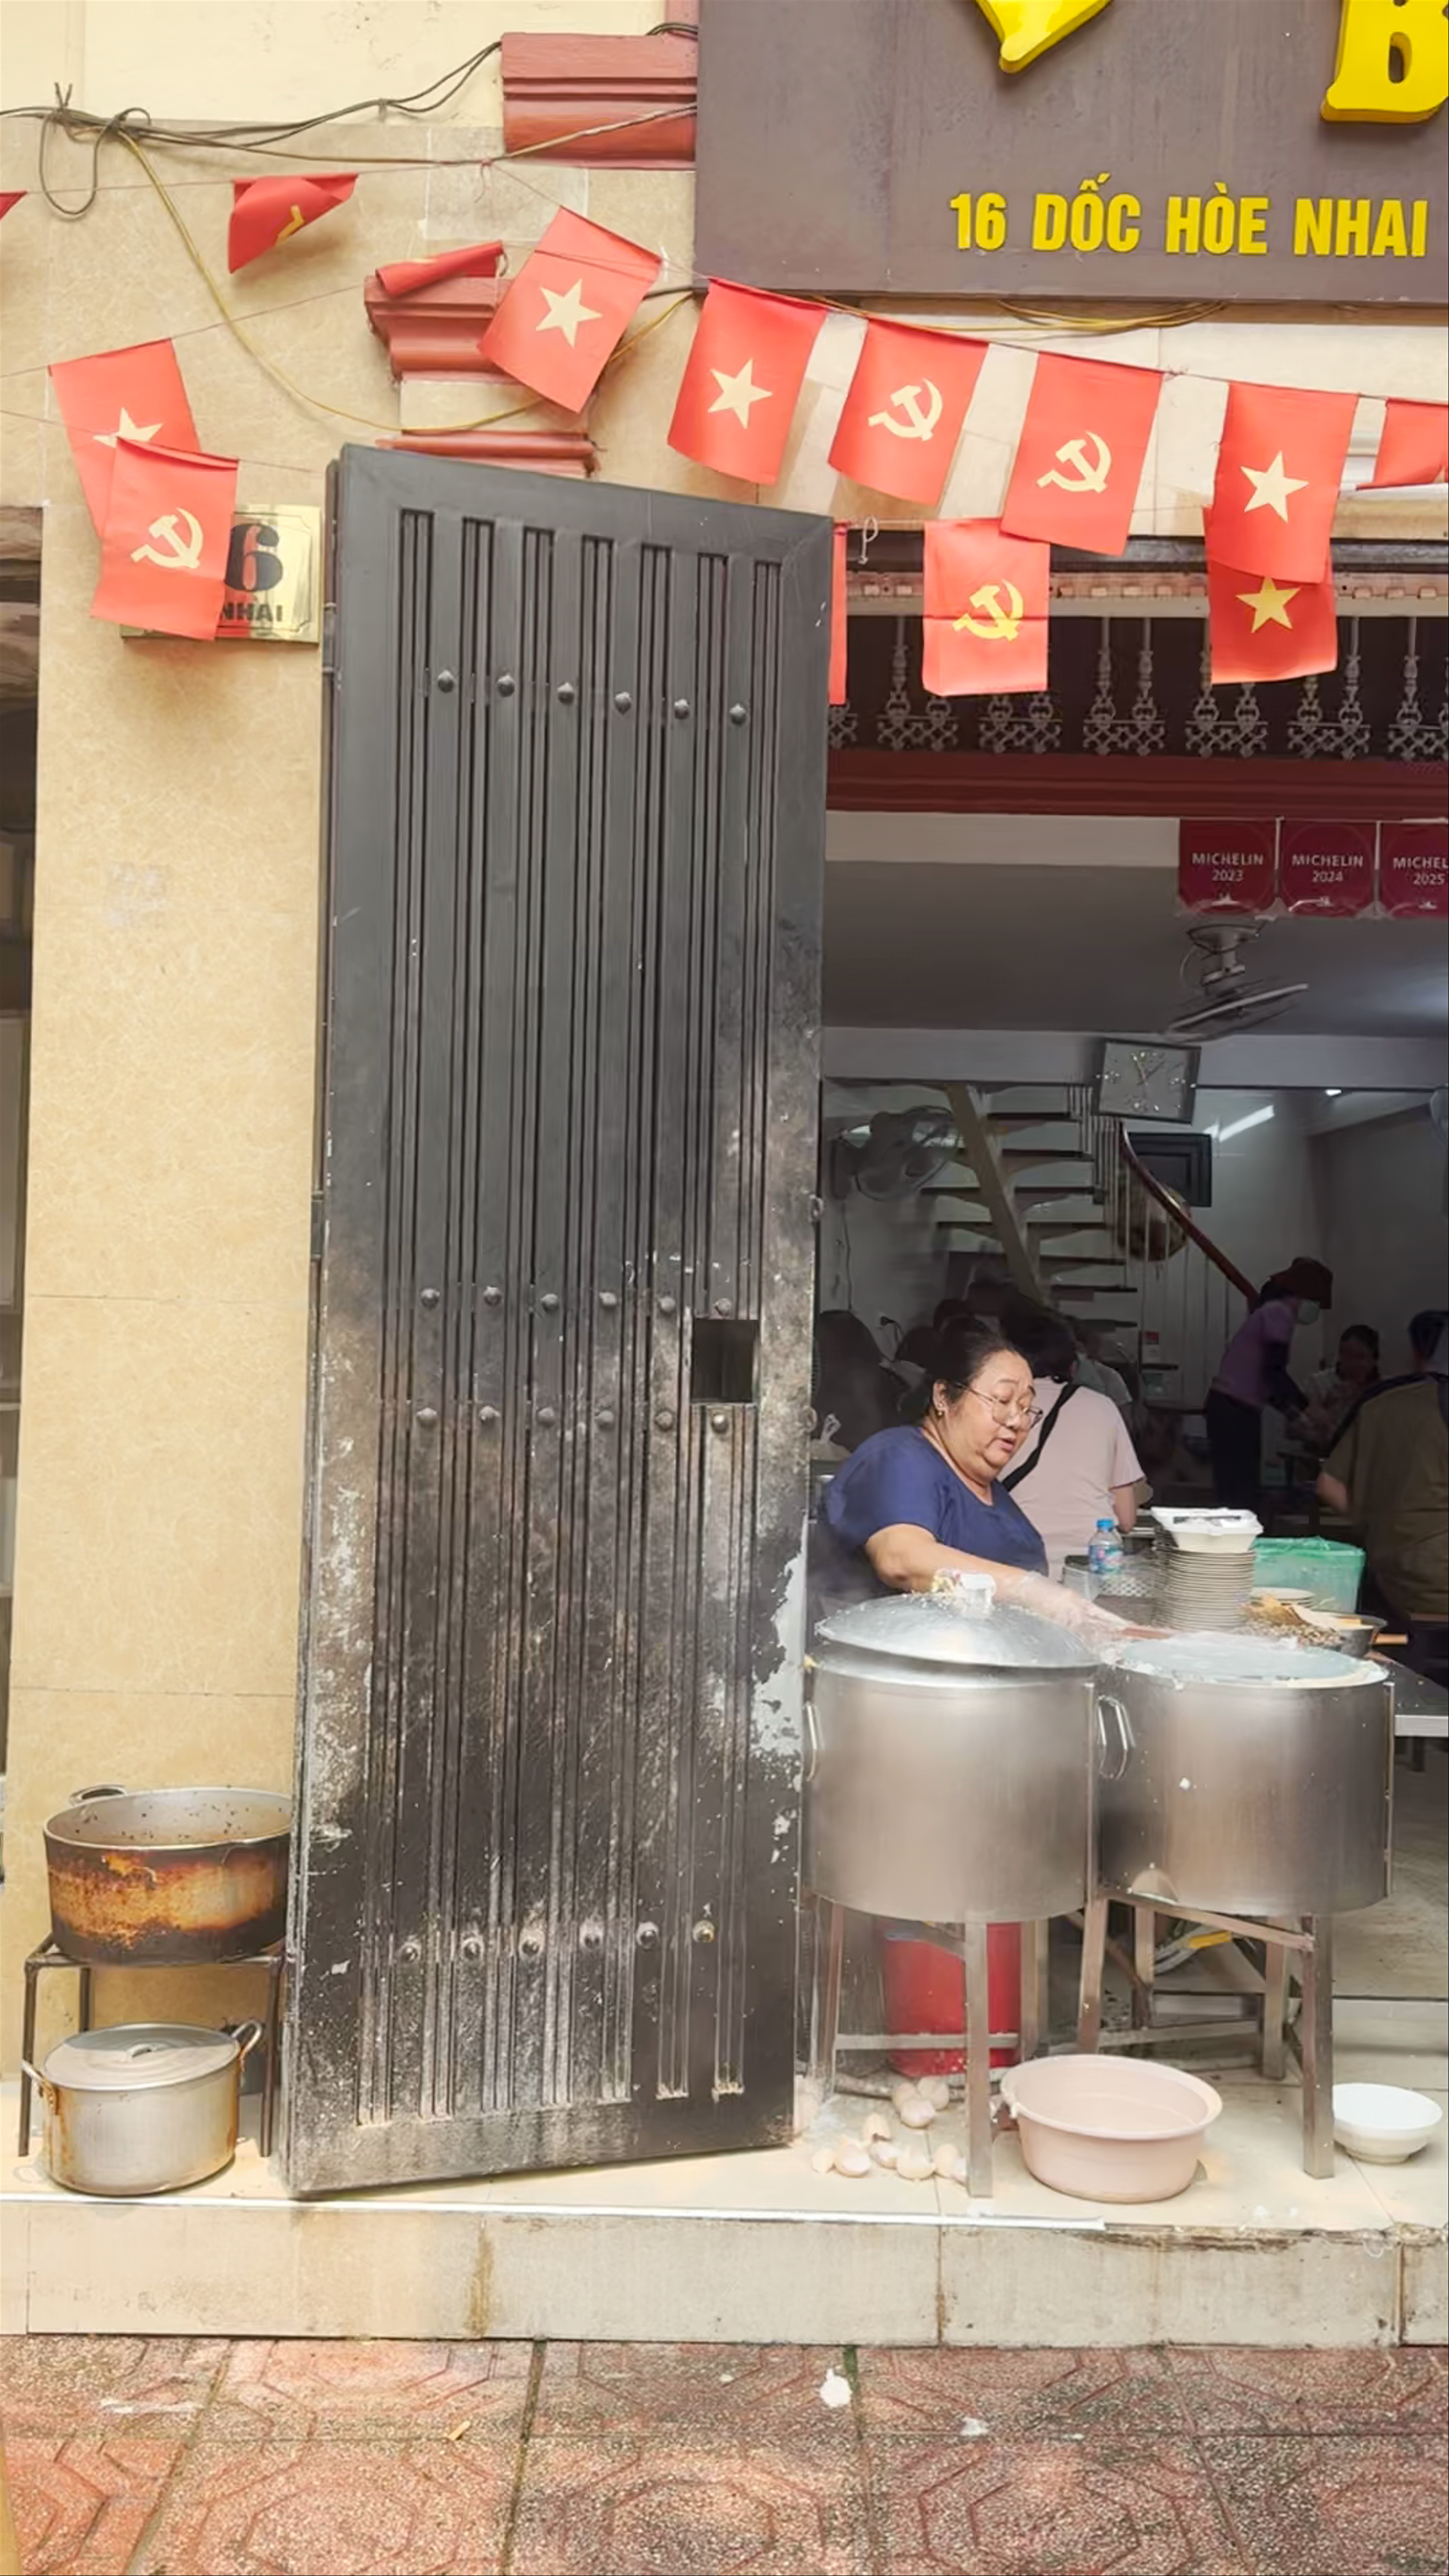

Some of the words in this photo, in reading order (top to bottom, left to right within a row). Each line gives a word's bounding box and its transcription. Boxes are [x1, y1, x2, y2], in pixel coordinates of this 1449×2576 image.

[950, 192, 1007, 251] 16
[1032, 173, 1141, 252] DỐC
[1164, 182, 1269, 255] HÒE
[1293, 197, 1428, 257] NHAI
[1192, 852, 1264, 866] MICHELIN
[1291, 854, 1364, 867] MICHELIN
[1212, 869, 1244, 882] 2023
[1311, 870, 1343, 882] 2024
[1413, 873, 1446, 885] 2025
